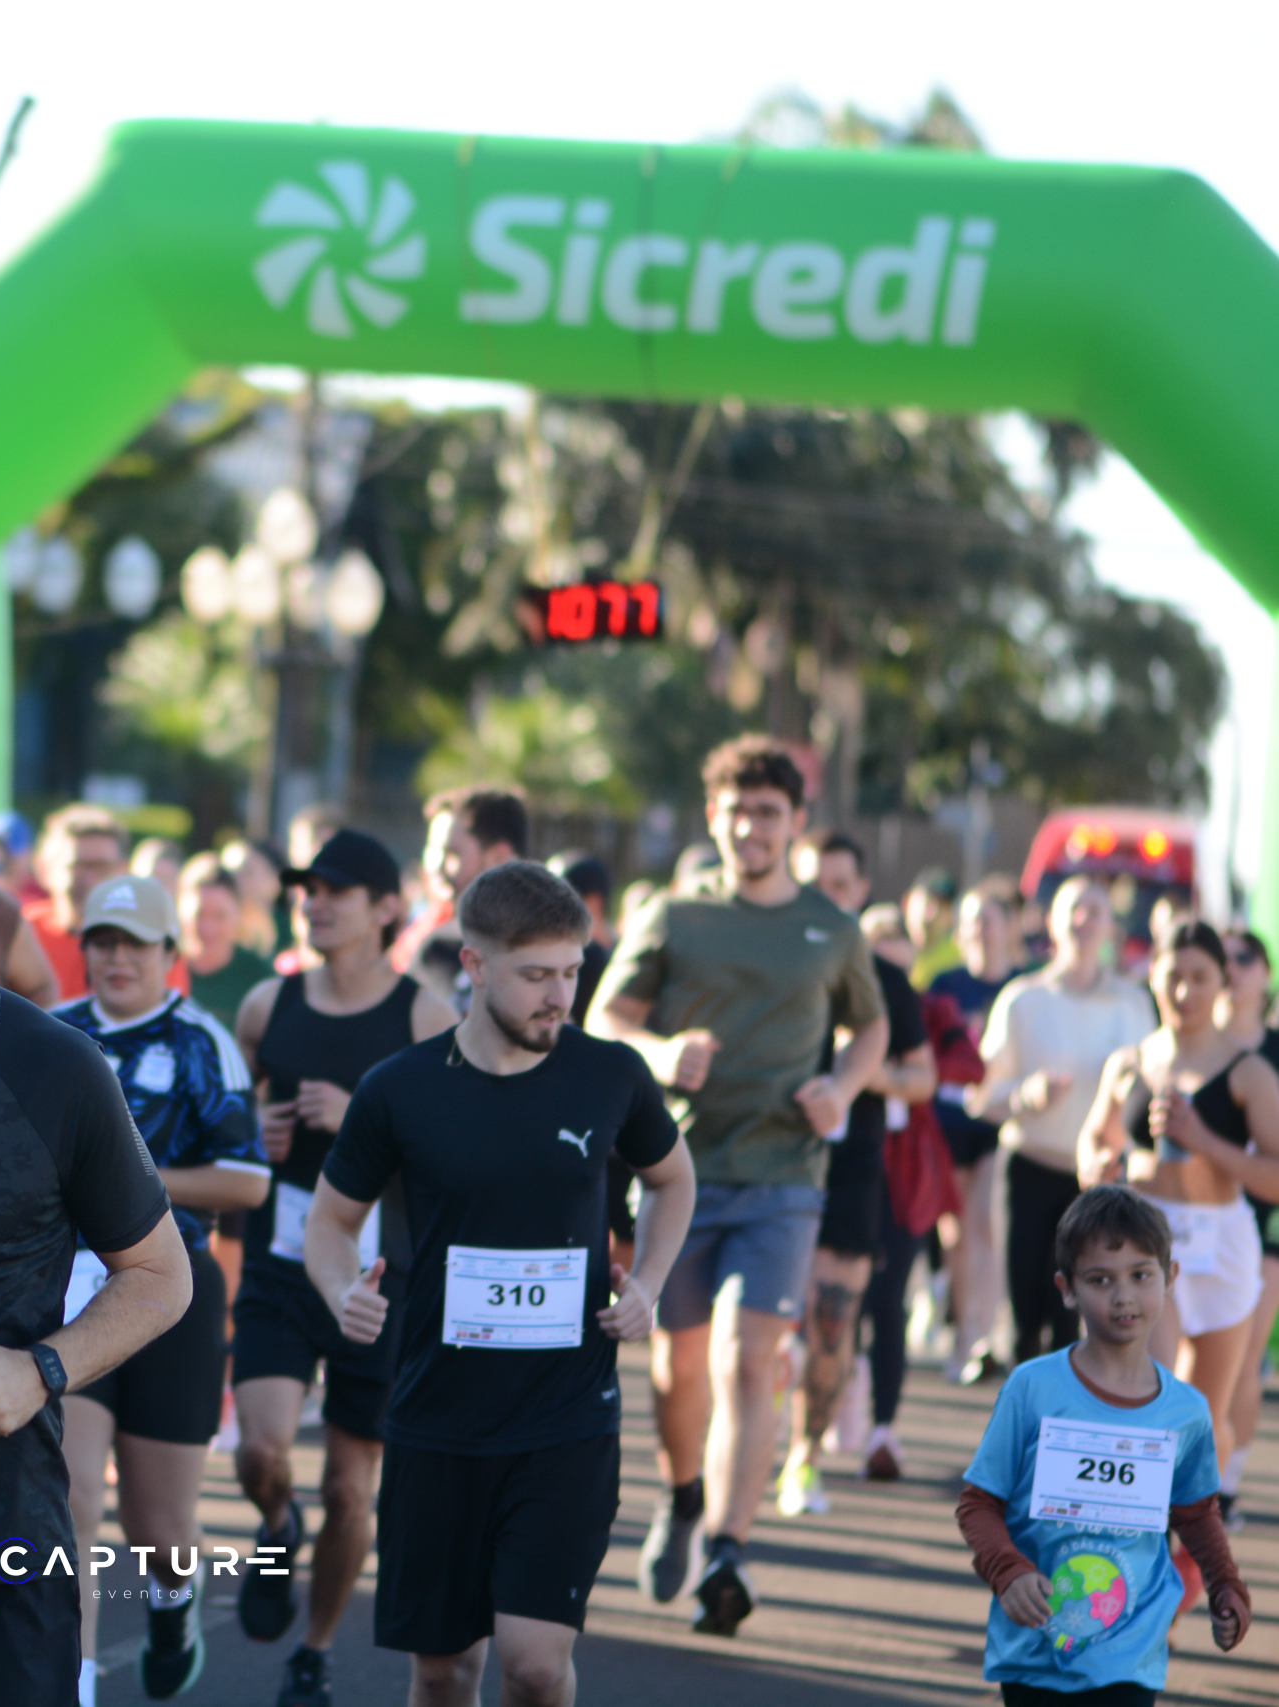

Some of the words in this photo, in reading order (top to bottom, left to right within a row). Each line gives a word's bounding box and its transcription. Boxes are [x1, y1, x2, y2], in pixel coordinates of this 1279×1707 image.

[458, 193, 996, 348] Sicredi
[487, 1283, 546, 1307] 310
[1076, 1457, 1136, 1486] 296
